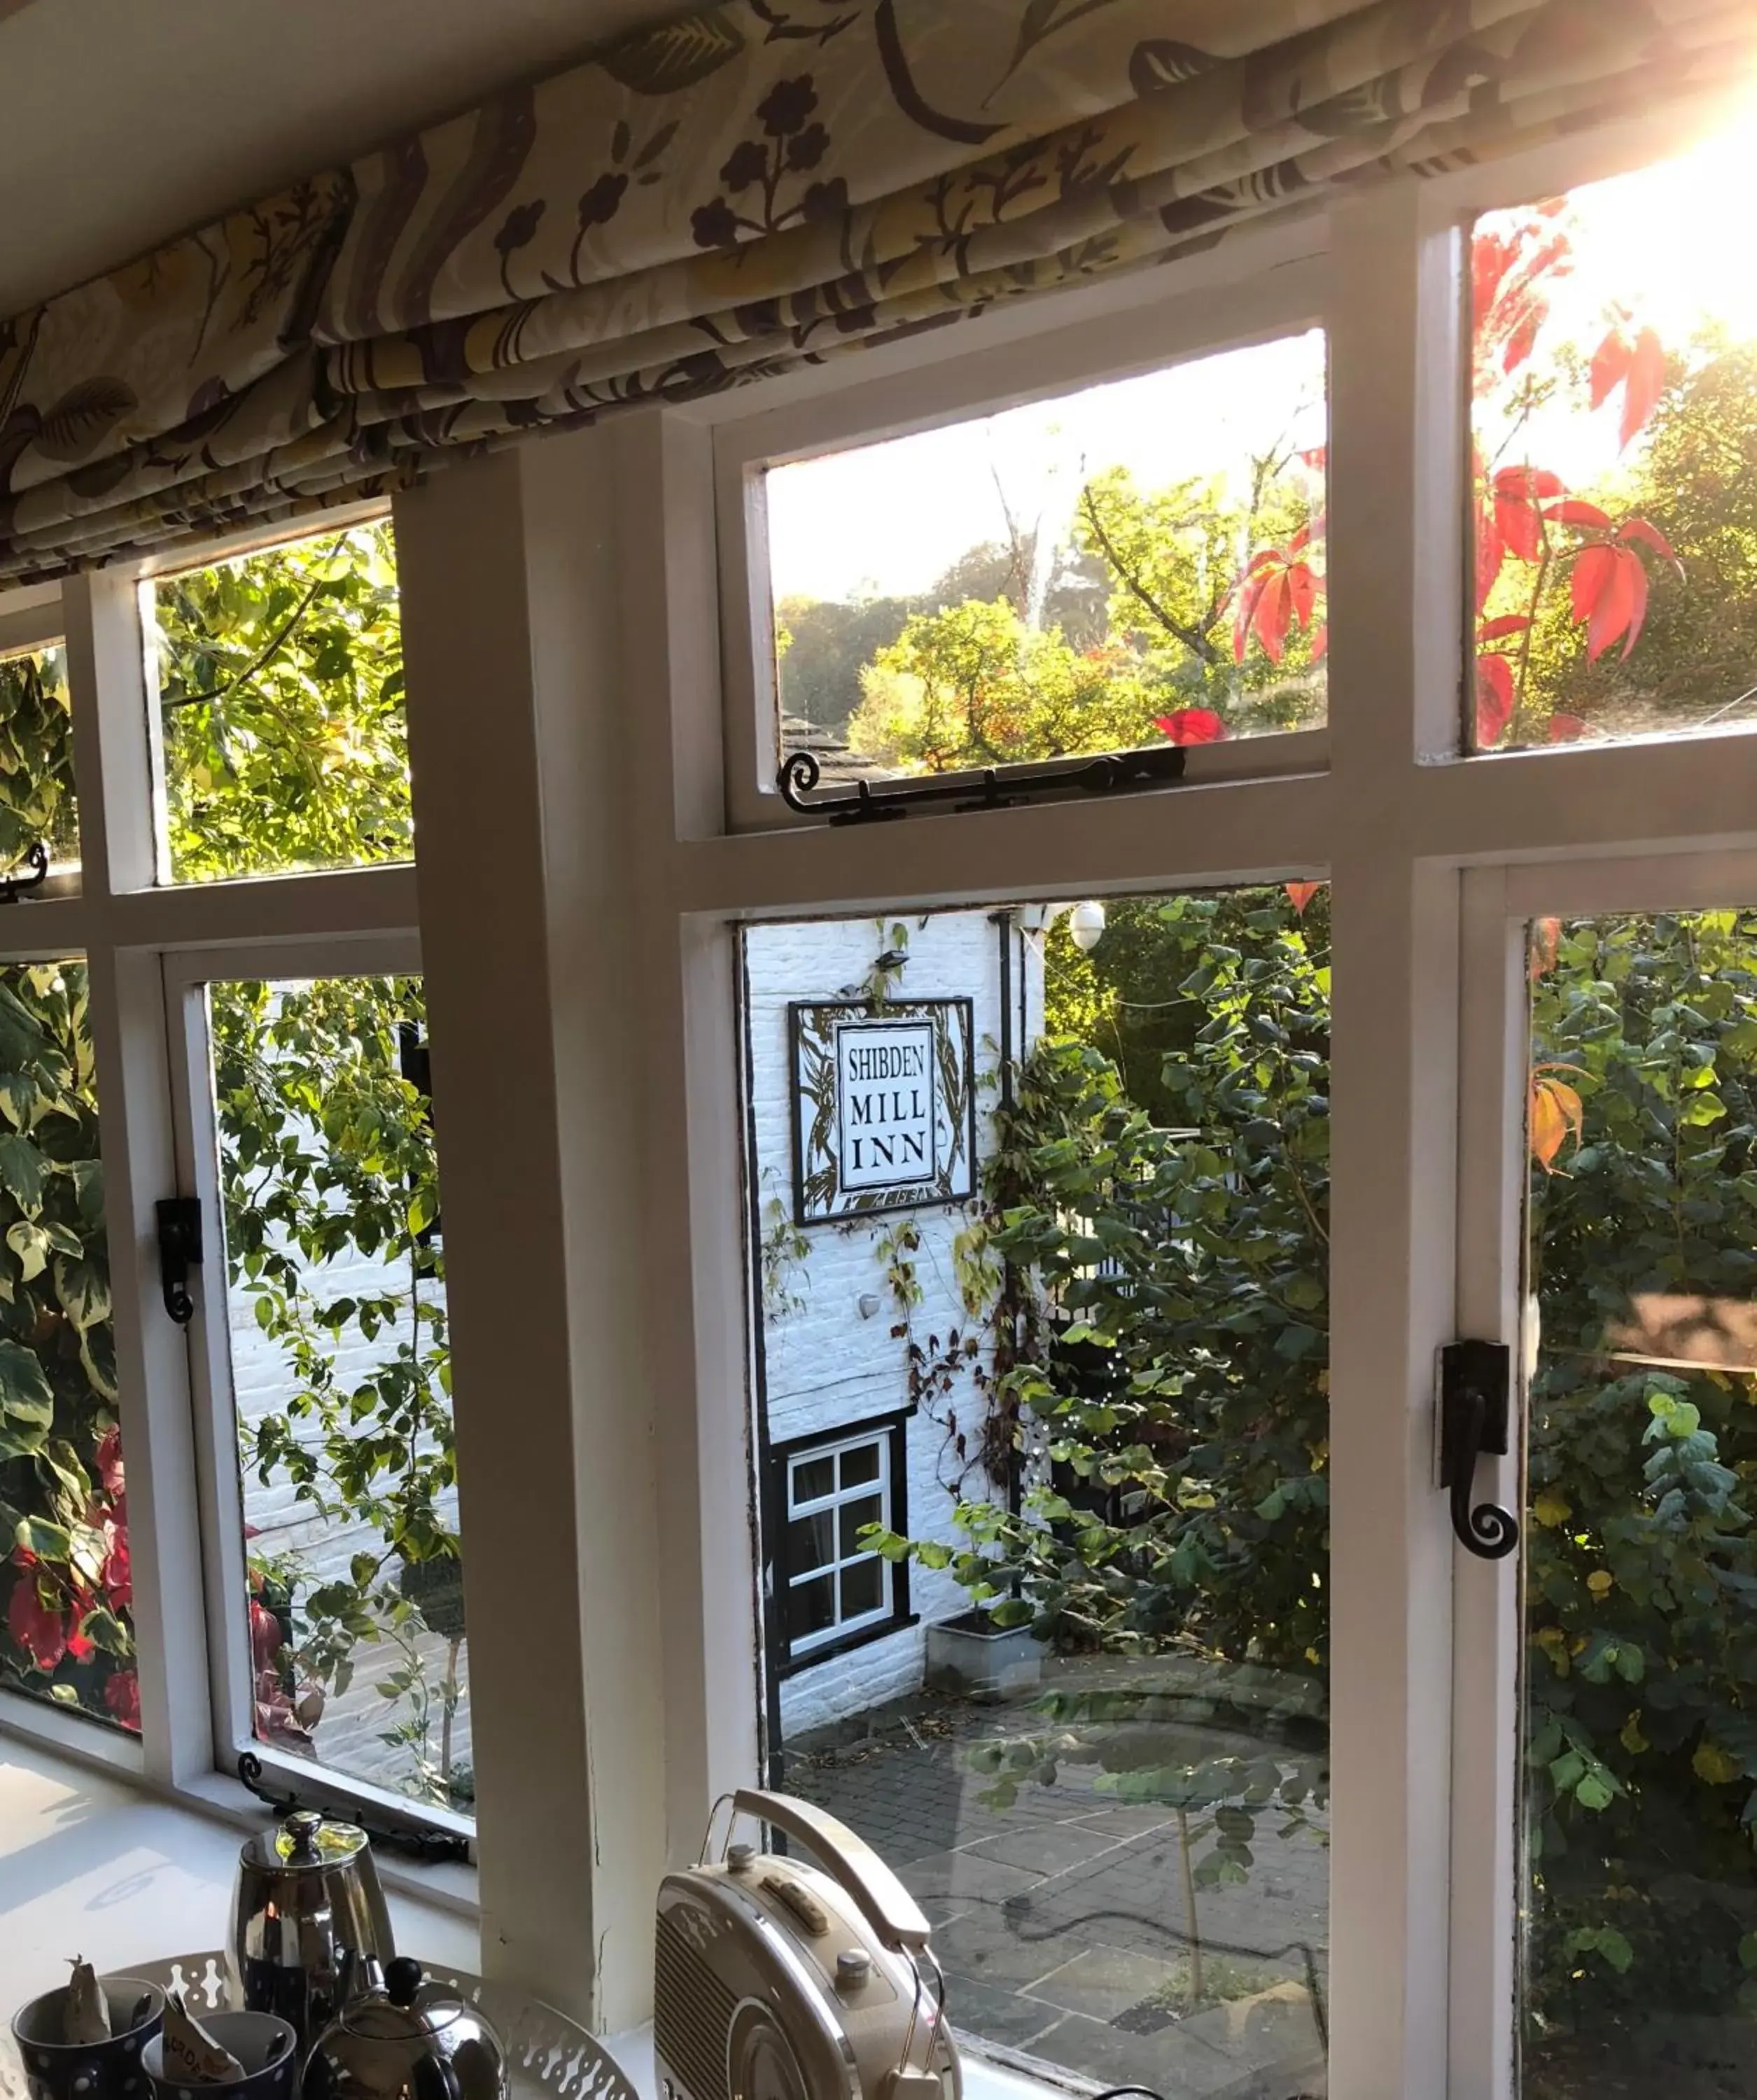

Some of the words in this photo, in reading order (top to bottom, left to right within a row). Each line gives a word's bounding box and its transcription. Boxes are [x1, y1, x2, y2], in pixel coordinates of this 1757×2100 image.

[849, 1044, 924, 1082] SHIBDEN
[850, 1089, 925, 1126] MILL
[852, 1131, 925, 1170] INN
